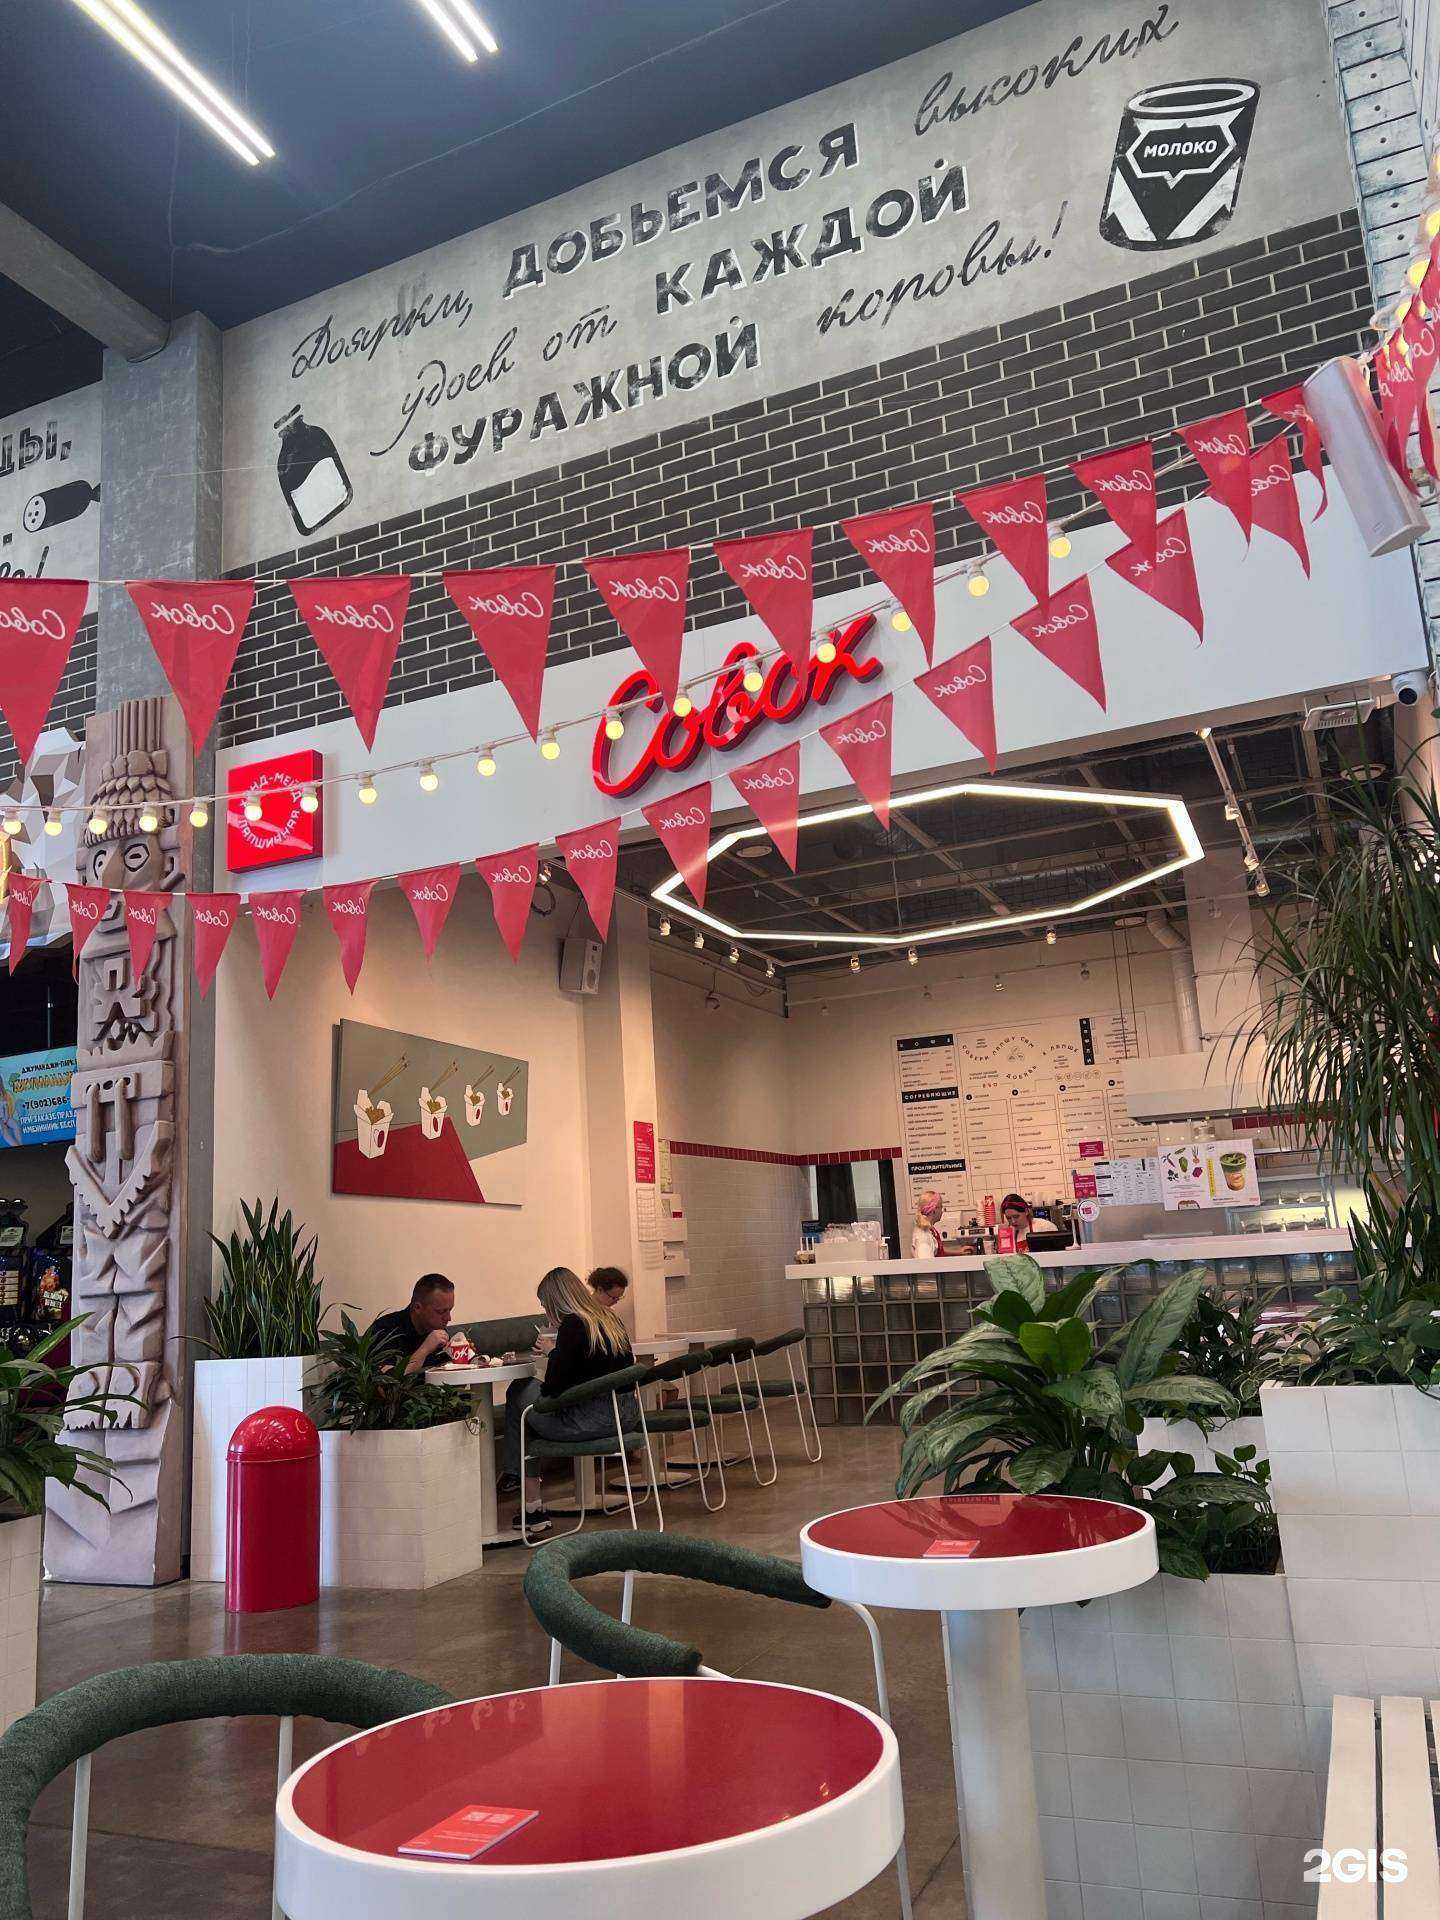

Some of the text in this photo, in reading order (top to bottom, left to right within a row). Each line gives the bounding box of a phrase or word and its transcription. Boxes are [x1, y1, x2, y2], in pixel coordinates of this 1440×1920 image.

[292, 4, 1179, 379] Доярки, ДОБЬЕМСЯ высоких
[1143, 139, 1218, 159] МОЛОКО
[370, 158, 970, 457] удоев от КАЖДОЙ
[408, 200, 1068, 476] ФУРАЖНОЙ коровы!
[240, 772, 303, 808] ХНД-МЕЙД
[592, 614, 883, 798] Совок
